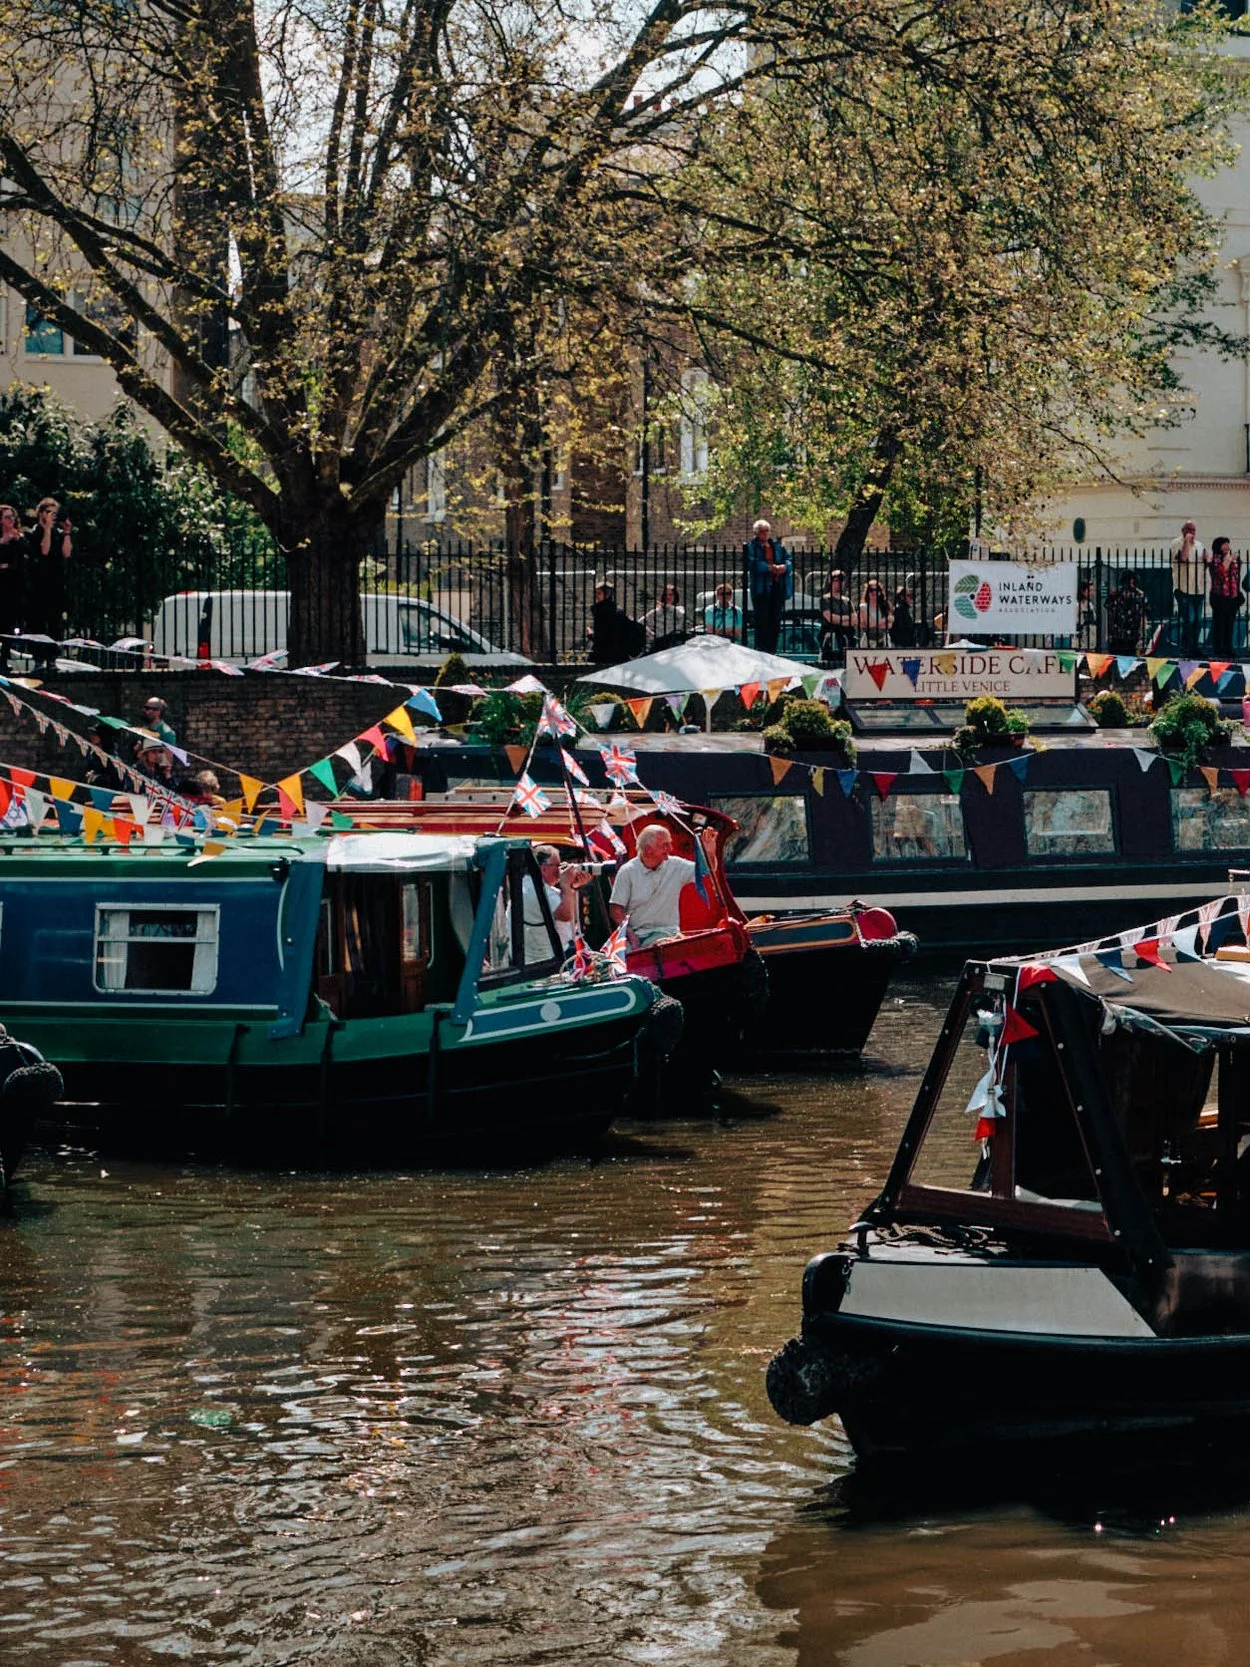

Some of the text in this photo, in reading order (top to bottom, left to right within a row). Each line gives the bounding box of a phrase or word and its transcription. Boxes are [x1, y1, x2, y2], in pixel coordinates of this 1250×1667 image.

[999, 582, 1043, 592] INLAND
[999, 595, 1073, 605] WATERWAYS
[914, 681, 1010, 692] LITTLE VENICE
